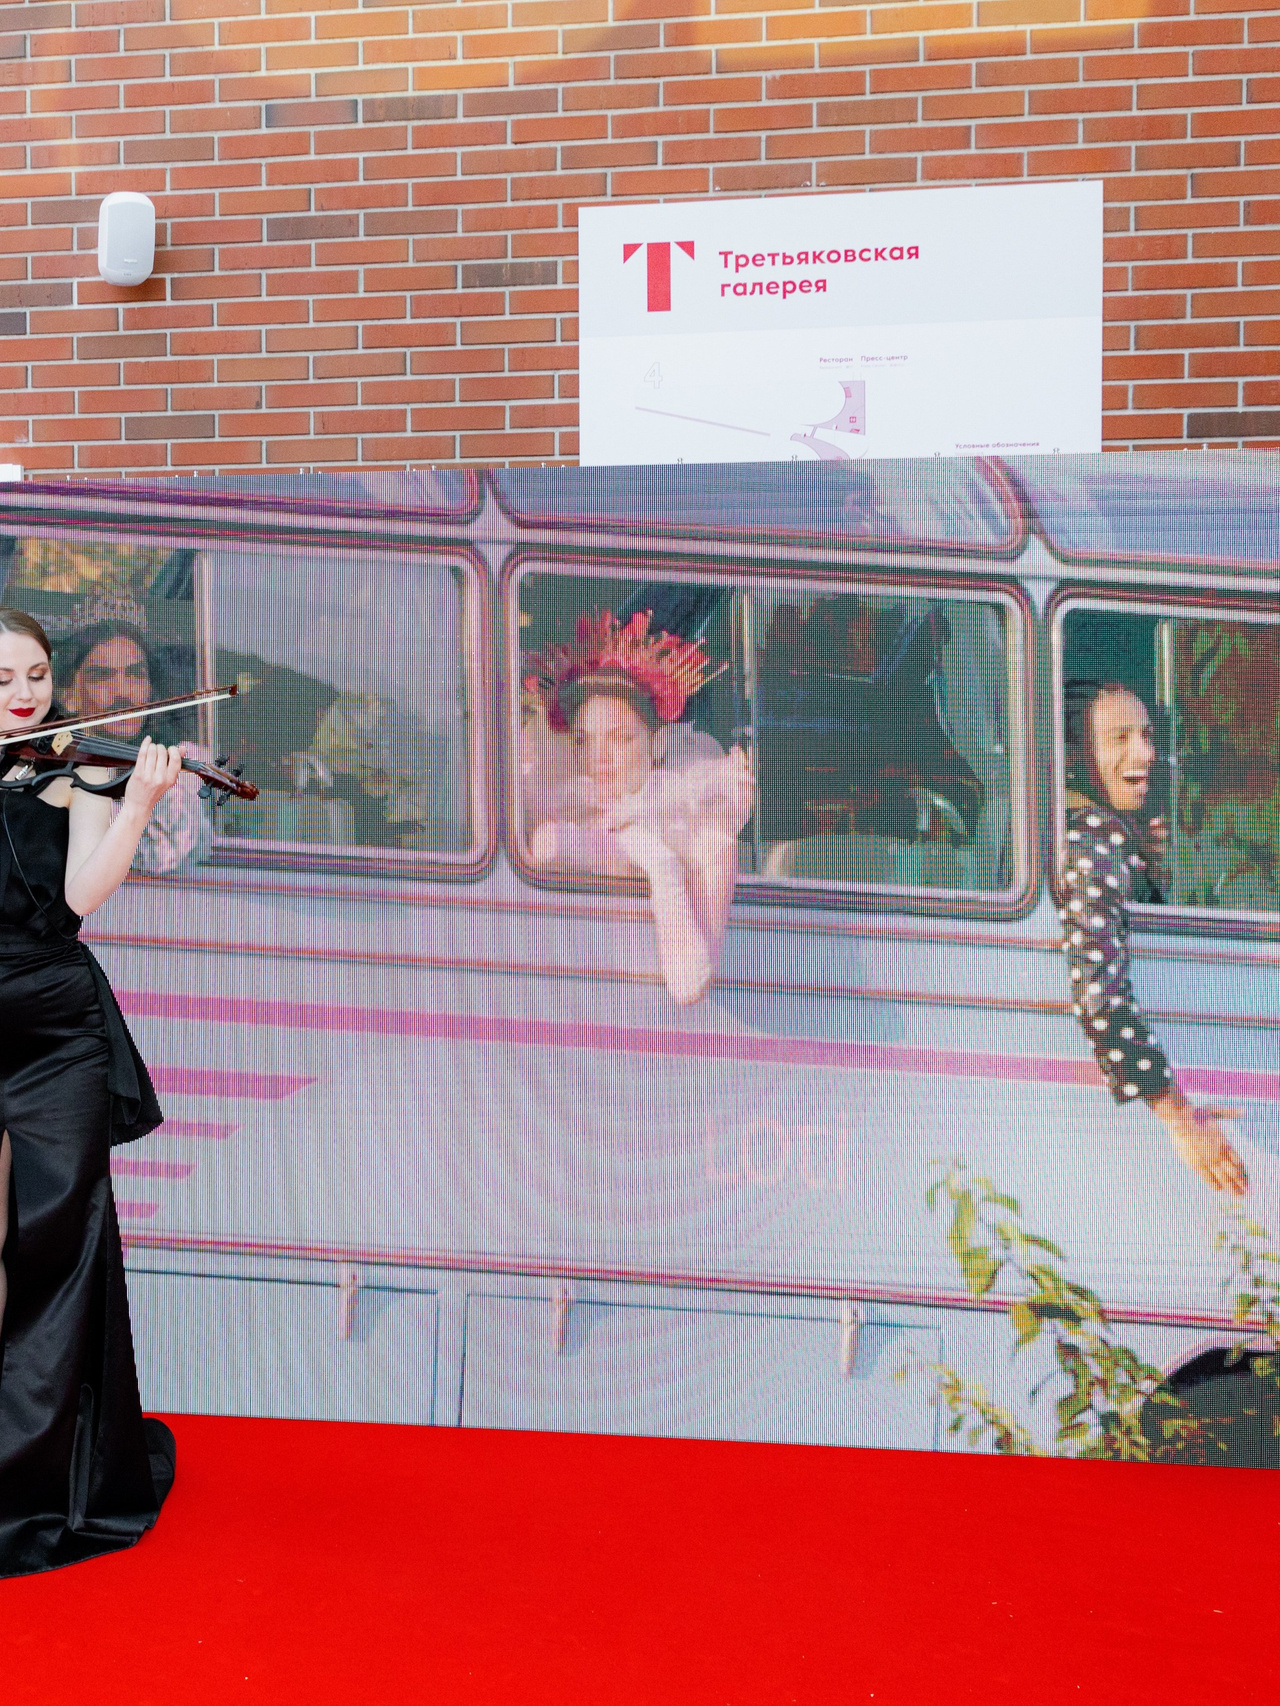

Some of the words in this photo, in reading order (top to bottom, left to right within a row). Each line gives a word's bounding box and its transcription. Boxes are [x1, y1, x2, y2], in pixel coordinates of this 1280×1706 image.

[718, 245, 920, 273] Третьяковская
[720, 278, 828, 300] галерея
[860, 355, 908, 363] Пресс-центр
[643, 361, 664, 390] 4
